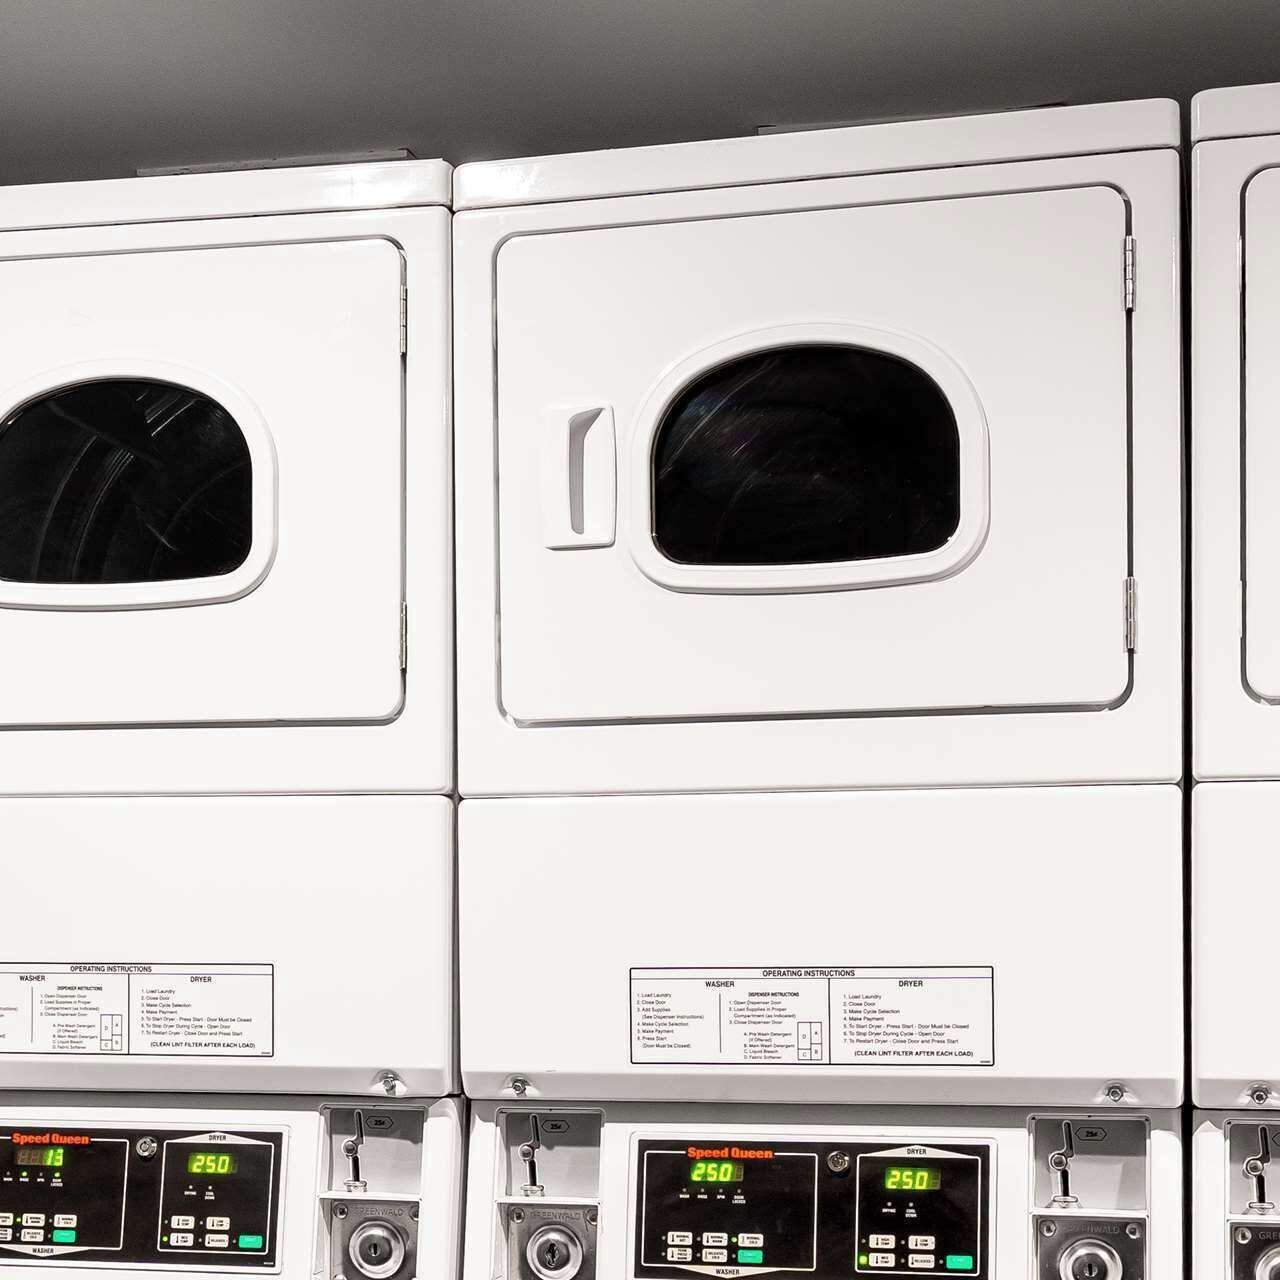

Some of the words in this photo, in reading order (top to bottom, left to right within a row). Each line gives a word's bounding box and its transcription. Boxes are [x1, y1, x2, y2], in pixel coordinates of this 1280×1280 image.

[12, 1133, 50, 1145] Speed
[51, 1134, 90, 1144] Queen
[688, 1147, 729, 1159] Speed
[731, 1148, 773, 1158] Queen
[192, 1155, 230, 1173] 250
[691, 1163, 733, 1181] 250
[887, 1170, 928, 1190] 250
